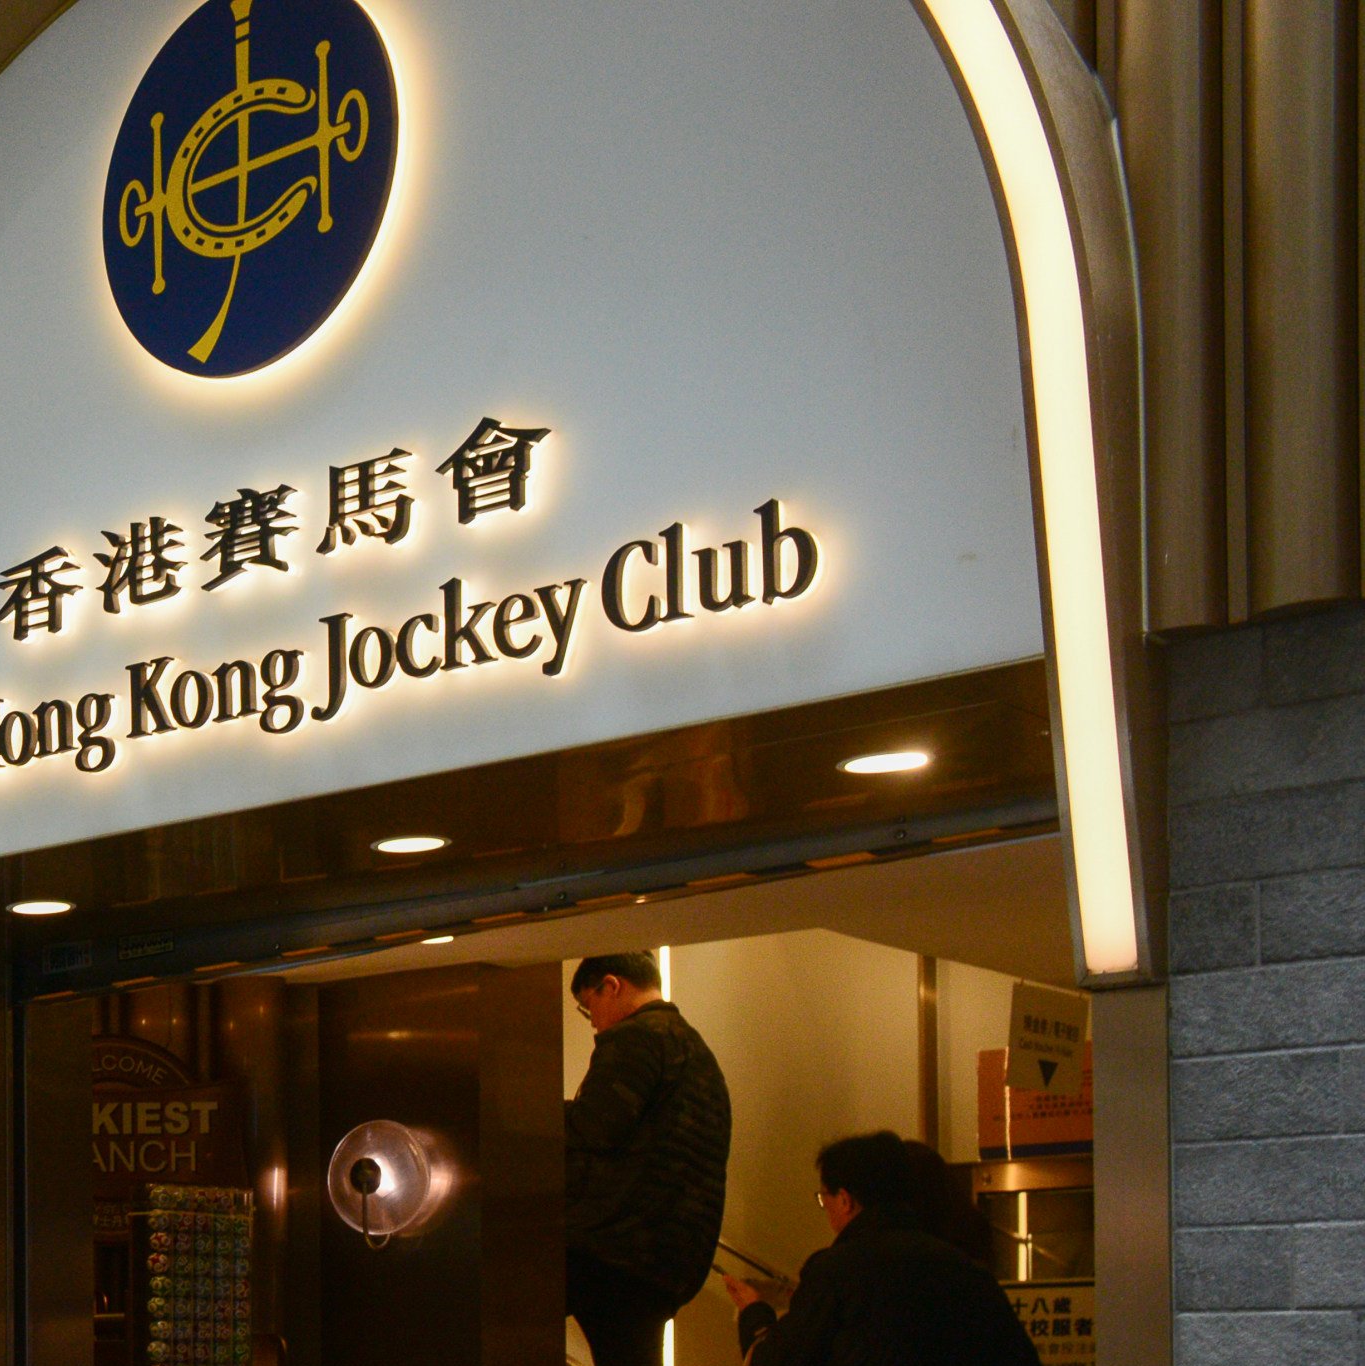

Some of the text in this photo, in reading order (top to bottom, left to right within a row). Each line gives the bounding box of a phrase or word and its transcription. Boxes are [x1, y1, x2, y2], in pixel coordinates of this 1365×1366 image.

[125, 649, 305, 734] Kong
[311, 577, 588, 722] Jockey
[601, 498, 818, 633] Club
